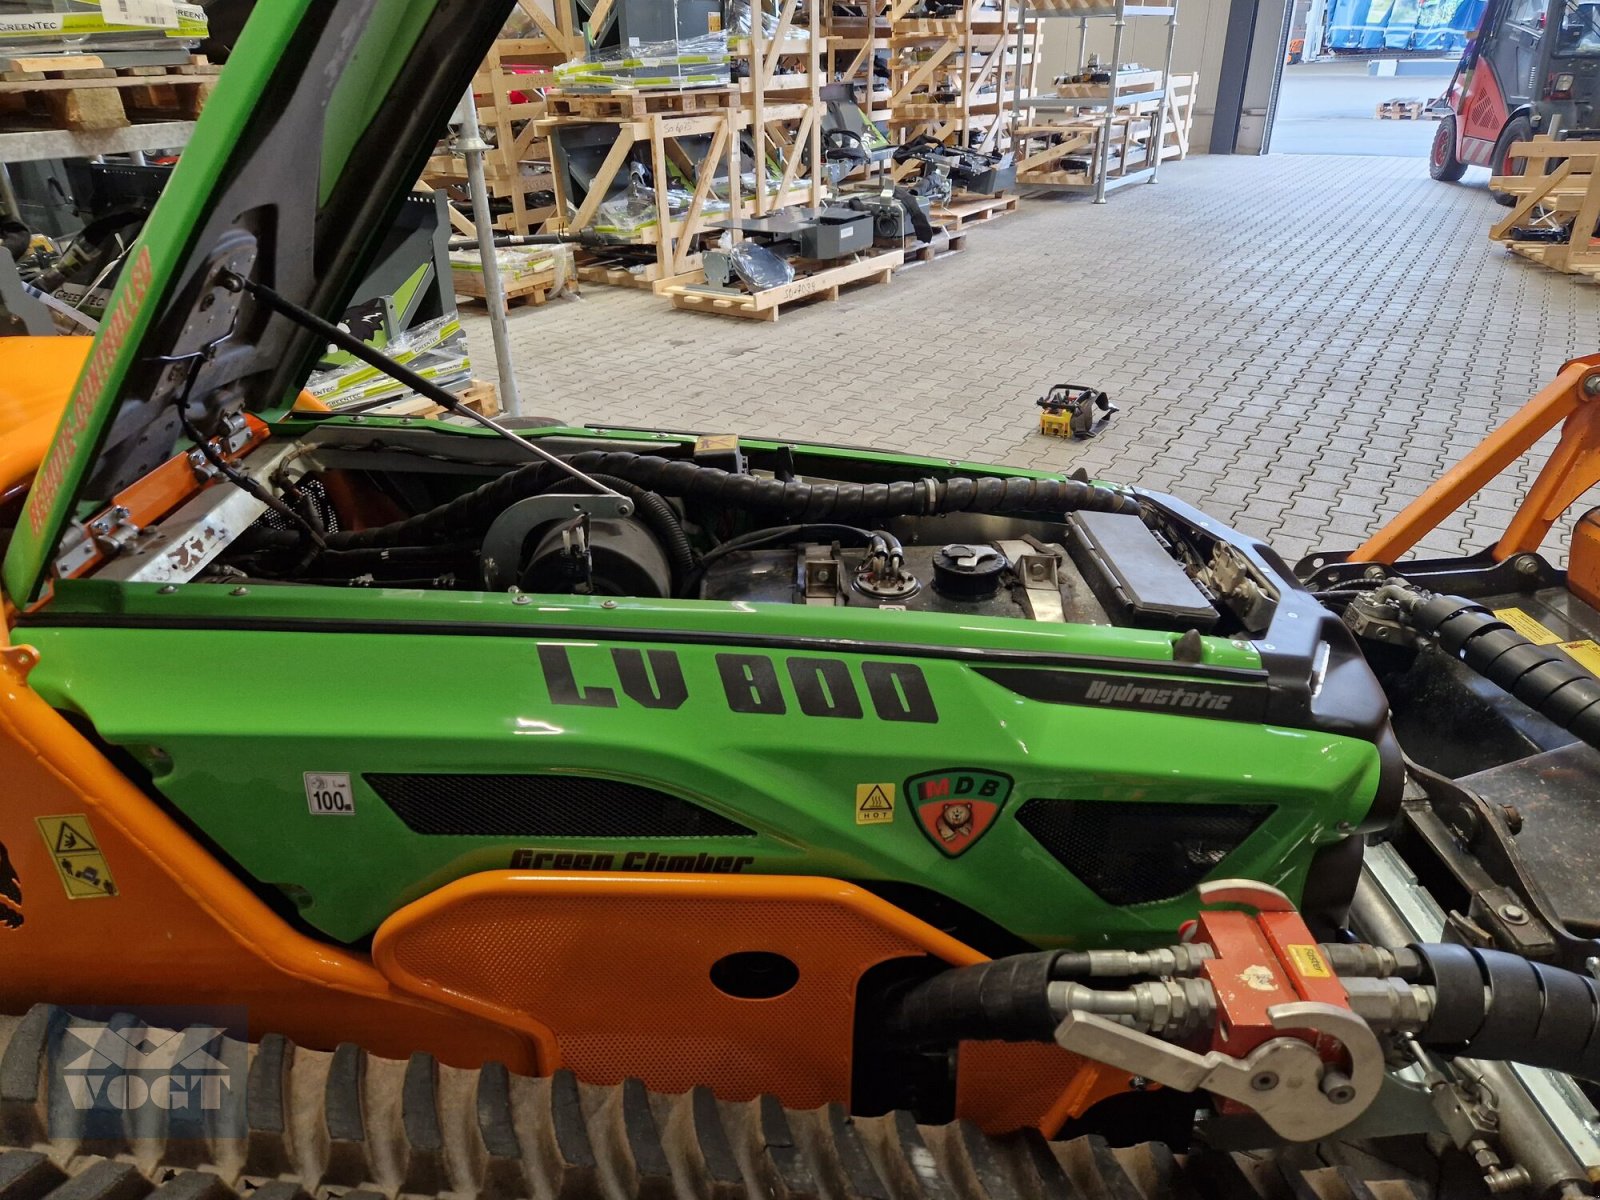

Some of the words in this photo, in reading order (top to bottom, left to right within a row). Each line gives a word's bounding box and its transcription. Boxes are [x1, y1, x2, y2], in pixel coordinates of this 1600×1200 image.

[54, 289, 104, 306] GREETEC
[536, 642, 689, 710] LV
[715, 653, 939, 724] 800
[1085, 680, 1233, 710] Hydrostatic
[313, 791, 344, 811] 100
[917, 776, 1000, 801] MDB
[863, 811, 888, 820] HOT
[509, 848, 615, 871] Green
[621, 851, 754, 873] Climber
